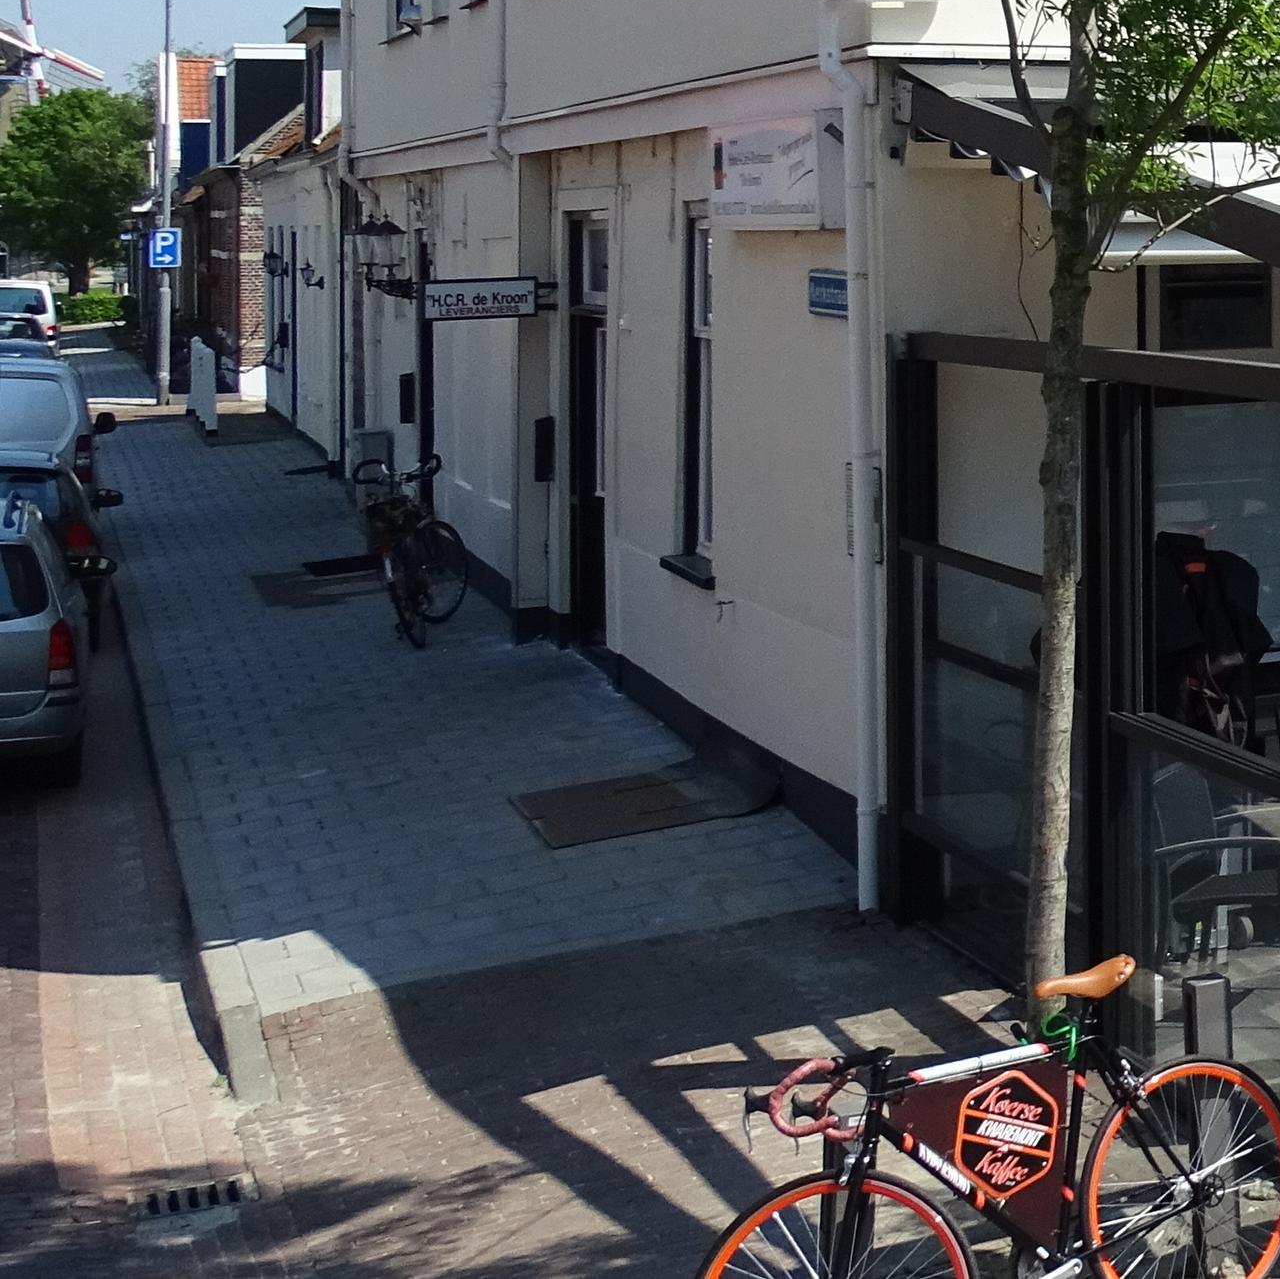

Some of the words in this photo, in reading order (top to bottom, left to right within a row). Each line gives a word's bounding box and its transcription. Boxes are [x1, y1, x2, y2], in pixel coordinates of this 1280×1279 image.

[155, 232, 175, 254] P
[439, 304, 521, 317] LEVERANCIERS
[472, 293, 488, 305] de
[979, 1086, 1043, 1121] Koerse
[976, 1119, 1046, 1147] KWAREMONT
[974, 1149, 1029, 1185] Kaffee
